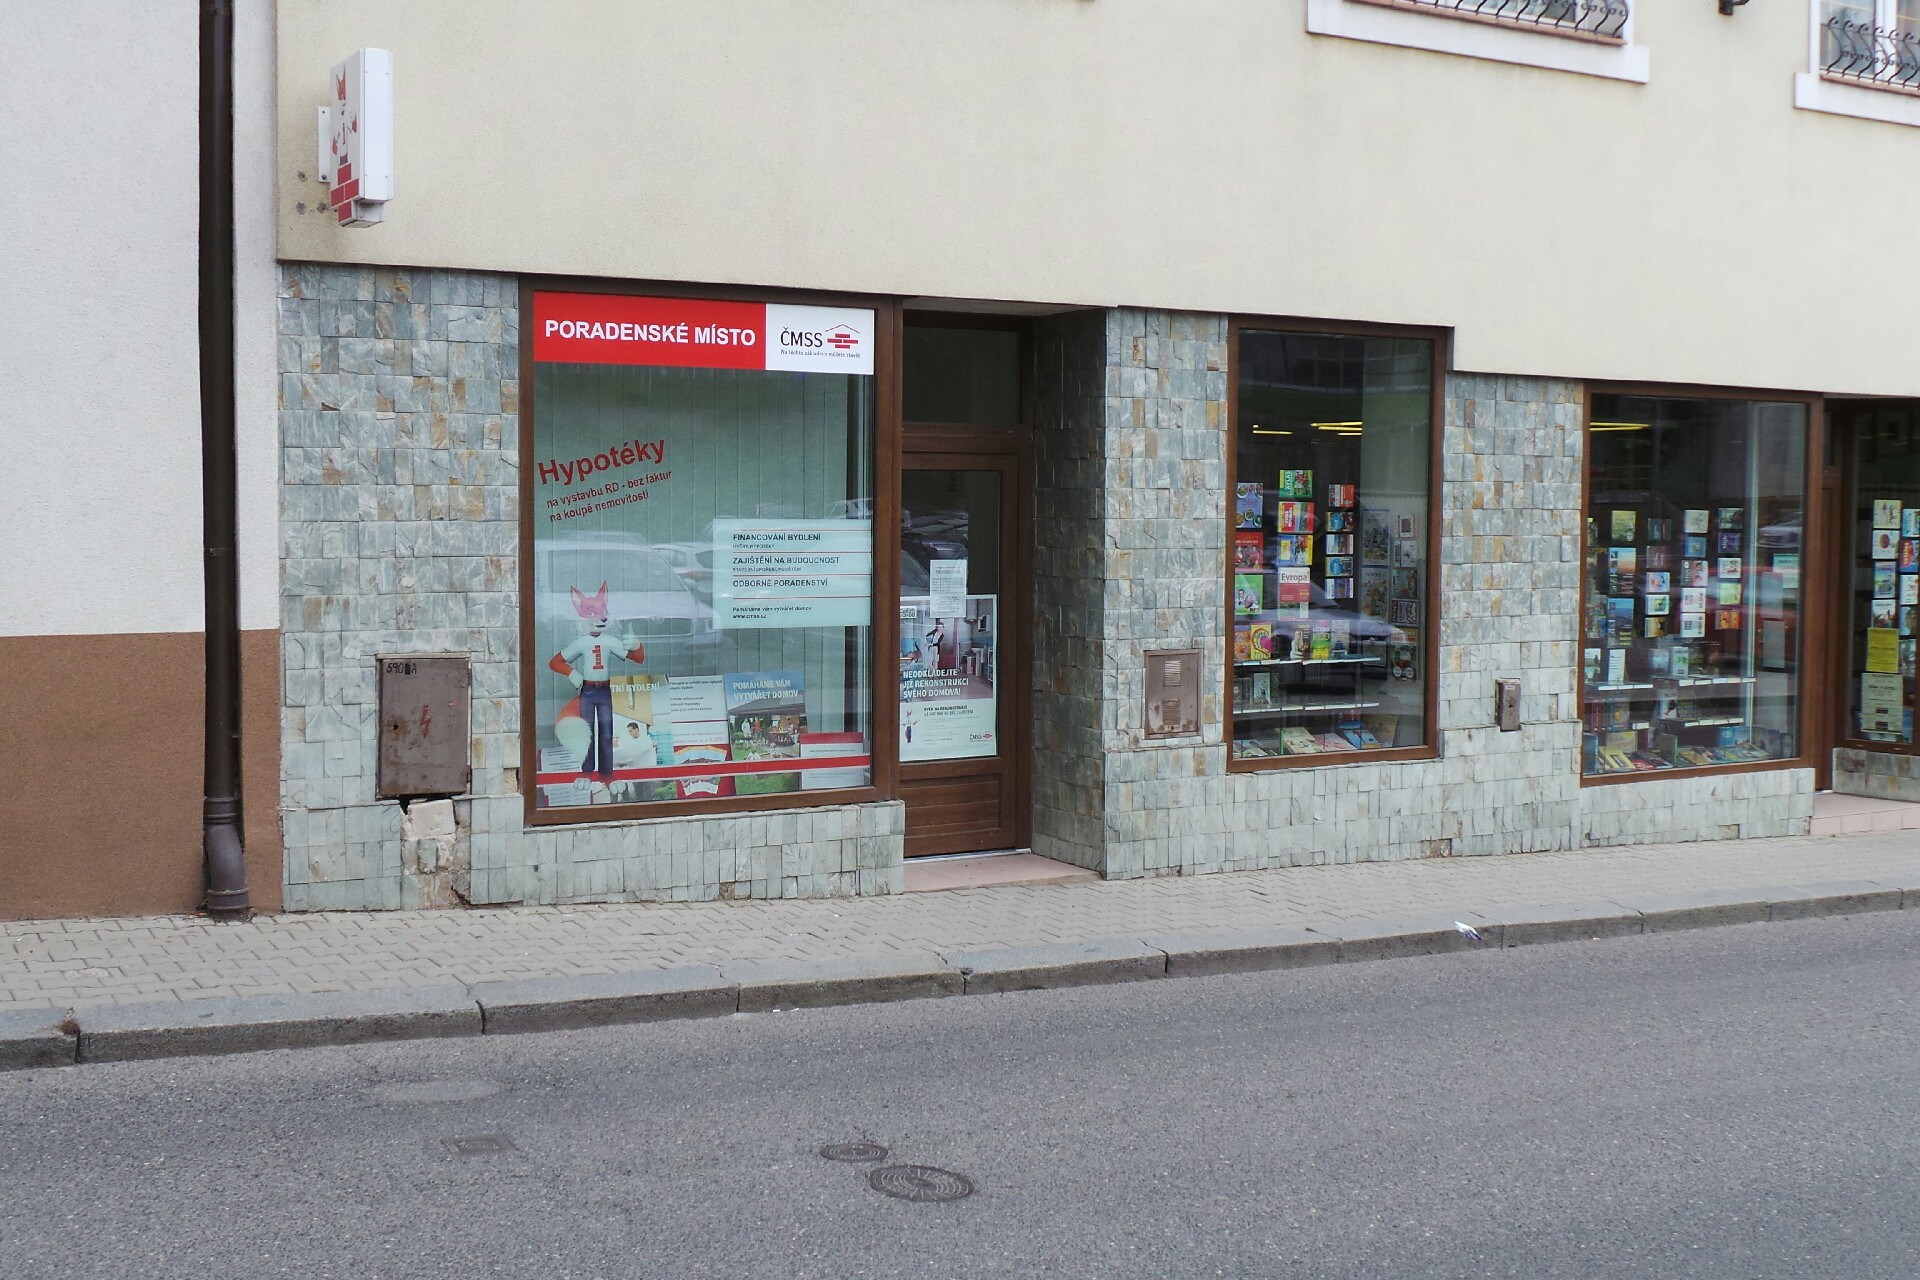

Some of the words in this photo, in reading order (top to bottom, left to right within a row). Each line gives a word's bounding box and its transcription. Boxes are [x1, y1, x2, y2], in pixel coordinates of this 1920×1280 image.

[545, 319, 688, 344] PORADENSKÉ
[694, 324, 756, 347] MÍSTO
[780, 326, 823, 348] ČMSS
[537, 439, 665, 486] Hypotéky
[546, 499, 558, 508] na
[560, 487, 603, 506] výstavbu
[605, 482, 619, 494] RD
[627, 478, 644, 489] bez
[645, 470, 673, 484] faktur
[549, 513, 562, 522] na
[564, 503, 593, 519] koupě
[595, 489, 650, 511] nemovitosti
[733, 532, 786, 541] FINANCOVÁNÍ
[787, 532, 821, 541] BYDLENÍ
[733, 555, 772, 564] ZAJIŠTĚNÍ
[786, 556, 840, 564] BUDOUCNOST
[733, 579, 772, 587] ODBORNÉ
[773, 578, 828, 587] PORADENSTVÍ
[1281, 573, 1307, 584] Evropa
[626, 681, 660, 692] BYDLENÍ
[775, 677, 791, 687] VÁM
[903, 679, 914, 688] JIŽ
[914, 677, 969, 688] REKONSTRUKCI
[733, 689, 771, 701] VYTVÁŘET
[772, 689, 799, 699] DOMOV
[903, 689, 927, 698] SVÉHO
[928, 687, 961, 697] DOMOVA!
